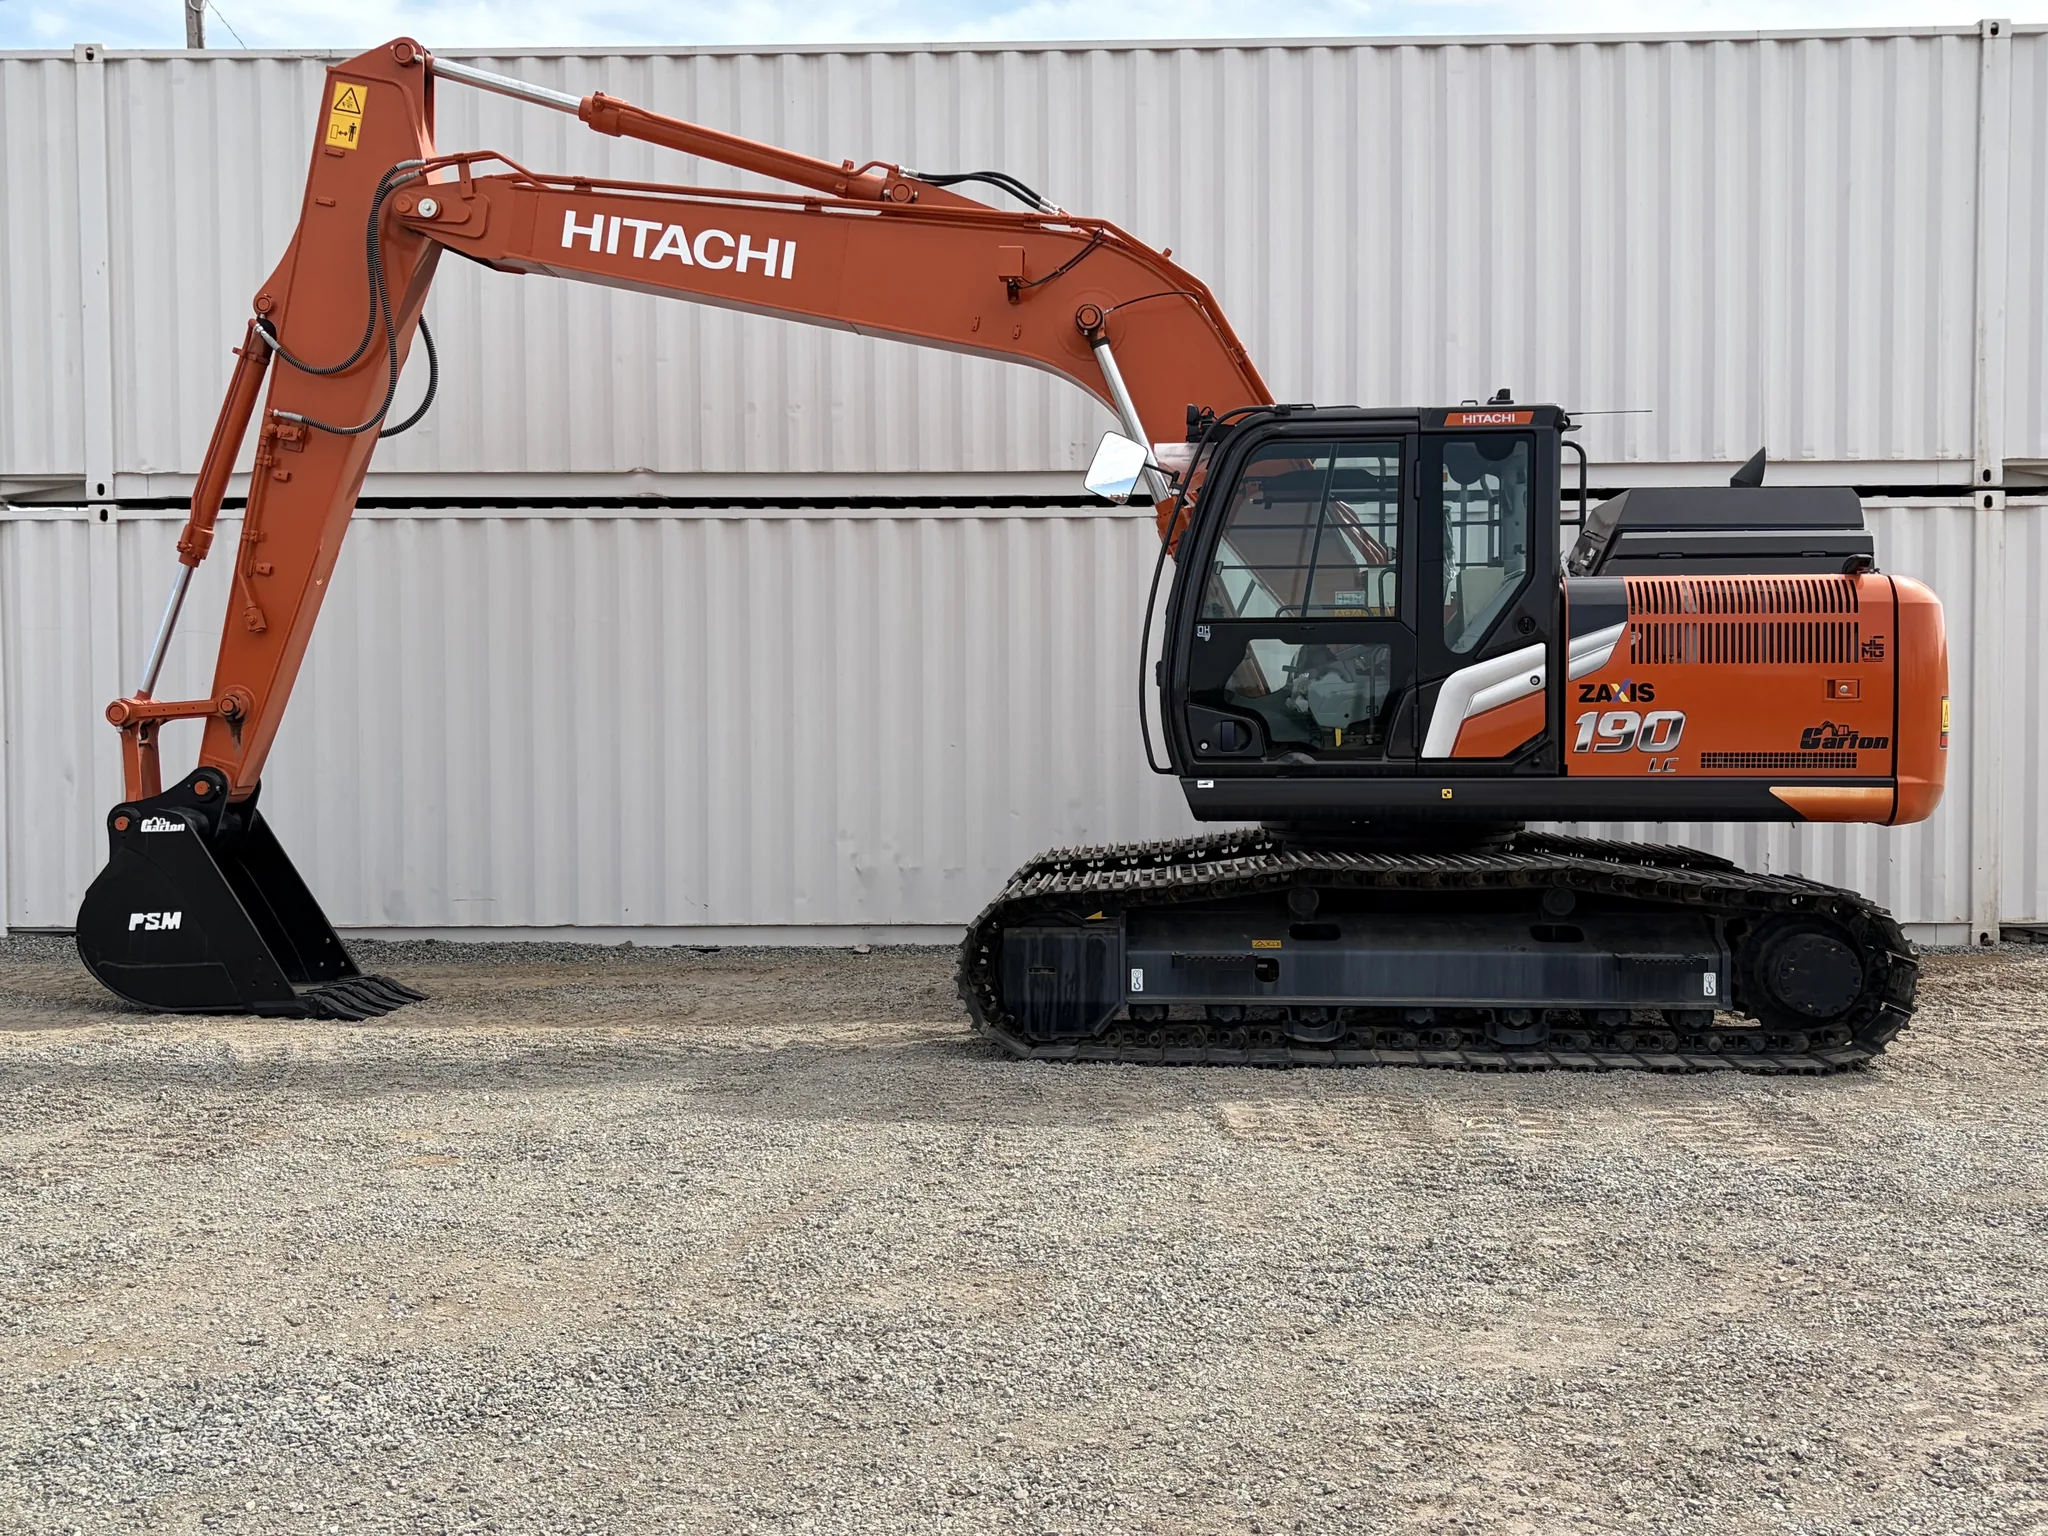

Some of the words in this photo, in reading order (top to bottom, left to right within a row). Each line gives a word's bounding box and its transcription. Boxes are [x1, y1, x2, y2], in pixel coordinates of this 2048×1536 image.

[561, 210, 796, 279] HITACHI
[1462, 413, 1516, 424] HITACHI
[1578, 678, 1655, 703] ZAXIS
[1573, 710, 1686, 753] 190
[1647, 757, 1680, 773] LC
[128, 911, 182, 931] PSM
